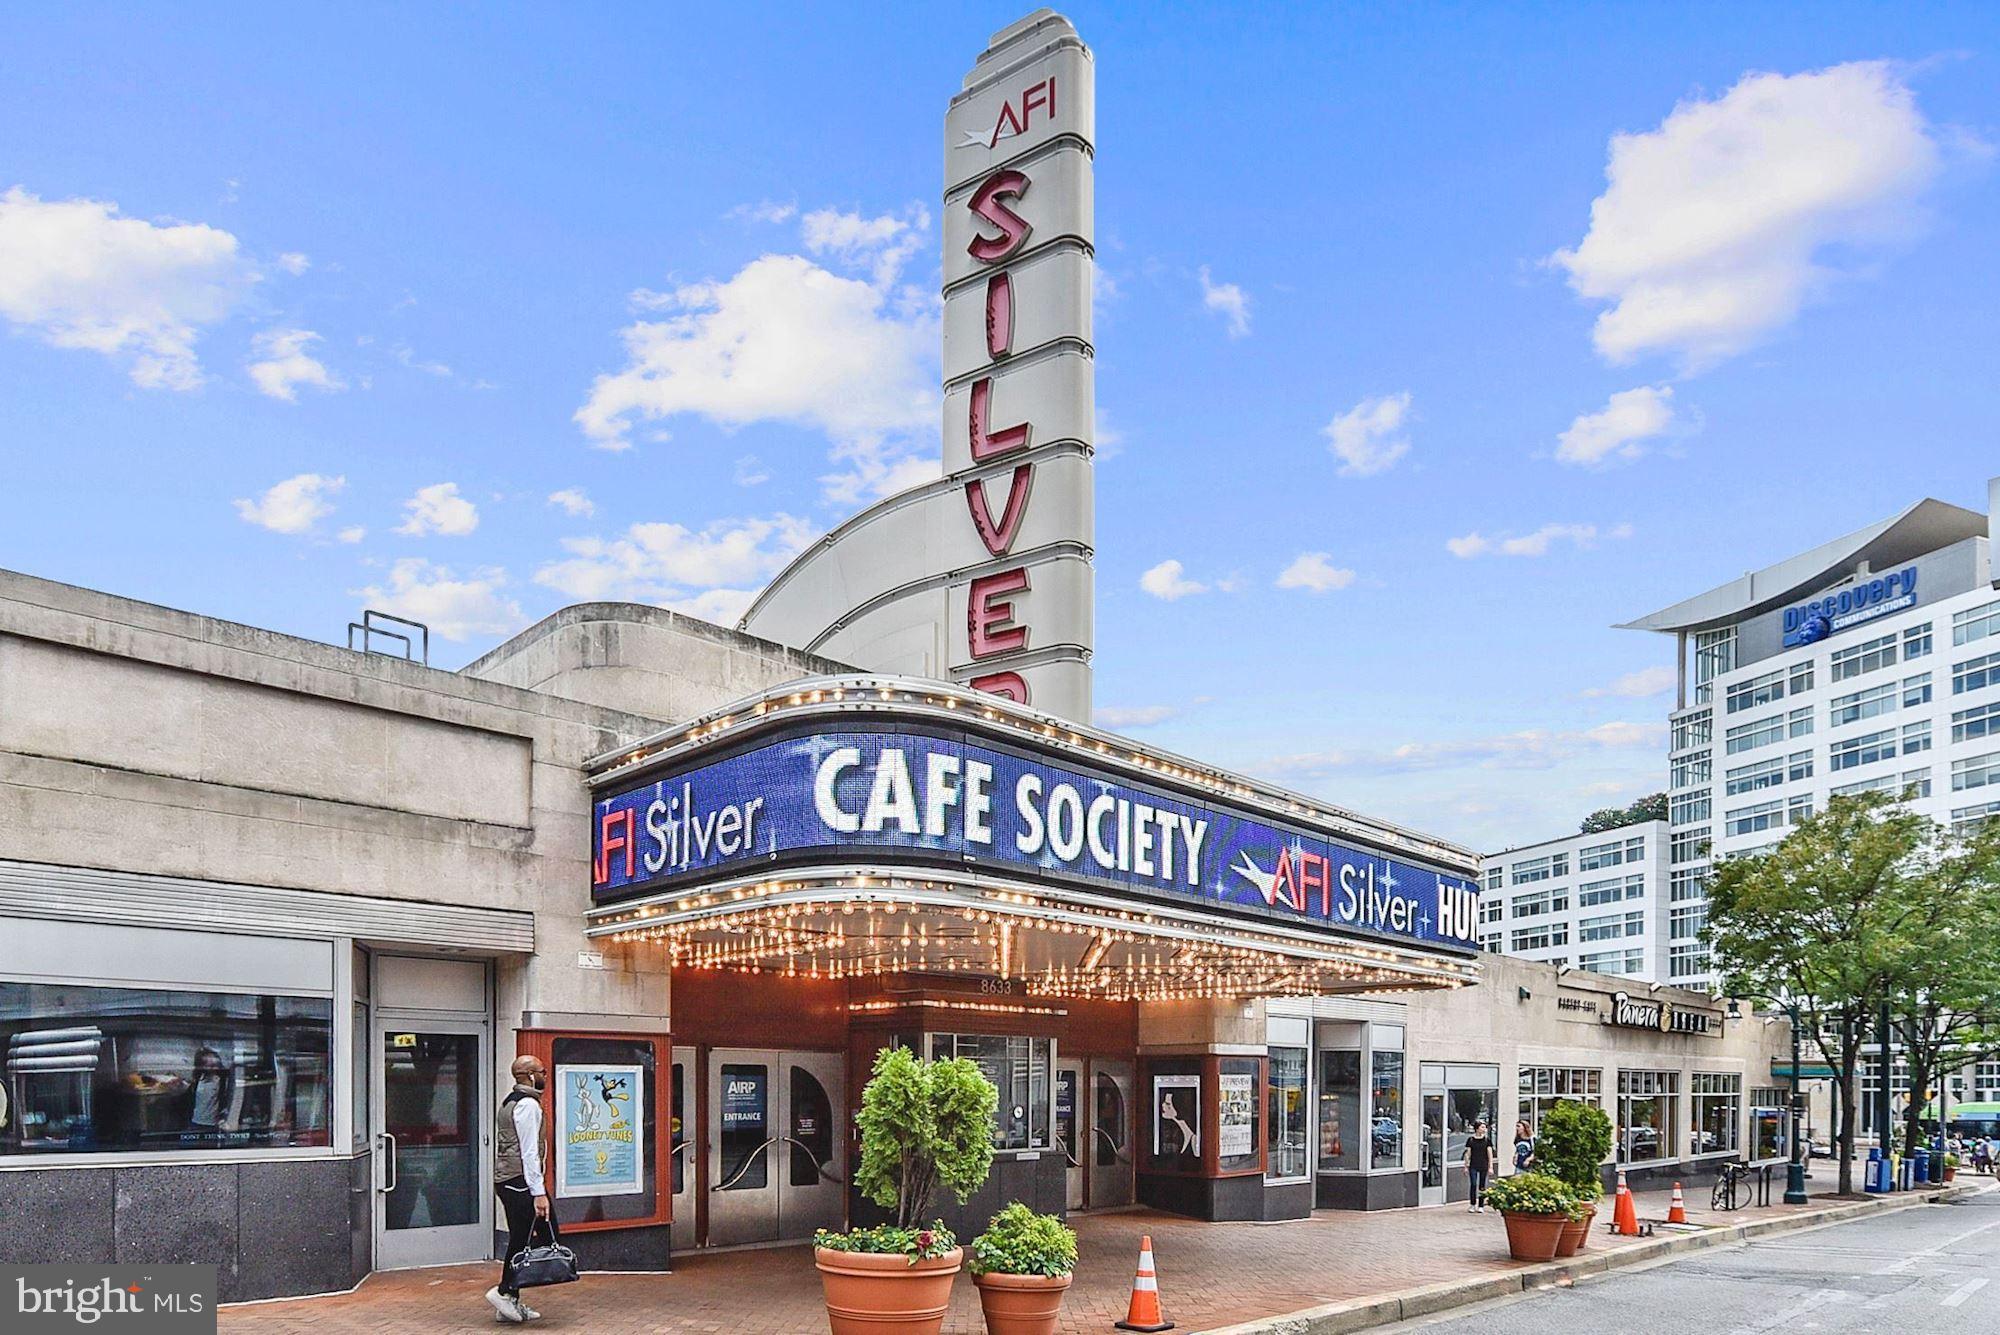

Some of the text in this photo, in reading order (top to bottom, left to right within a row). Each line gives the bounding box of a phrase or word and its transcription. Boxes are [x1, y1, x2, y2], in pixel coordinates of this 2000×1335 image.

[991, 76, 1056, 148] AFI
[643, 782, 765, 873] Silver
[814, 748, 1208, 886] CAFE SOCIETY
[1269, 846, 1419, 933] AFI Silver
[981, 980, 1012, 996] 8633
[1615, 991, 1659, 1028] Panera
[727, 1081, 756, 1094] AIRP
[723, 1112, 761, 1121] ENTRANCE
[568, 1130, 634, 1145] LOONEY TUNES
